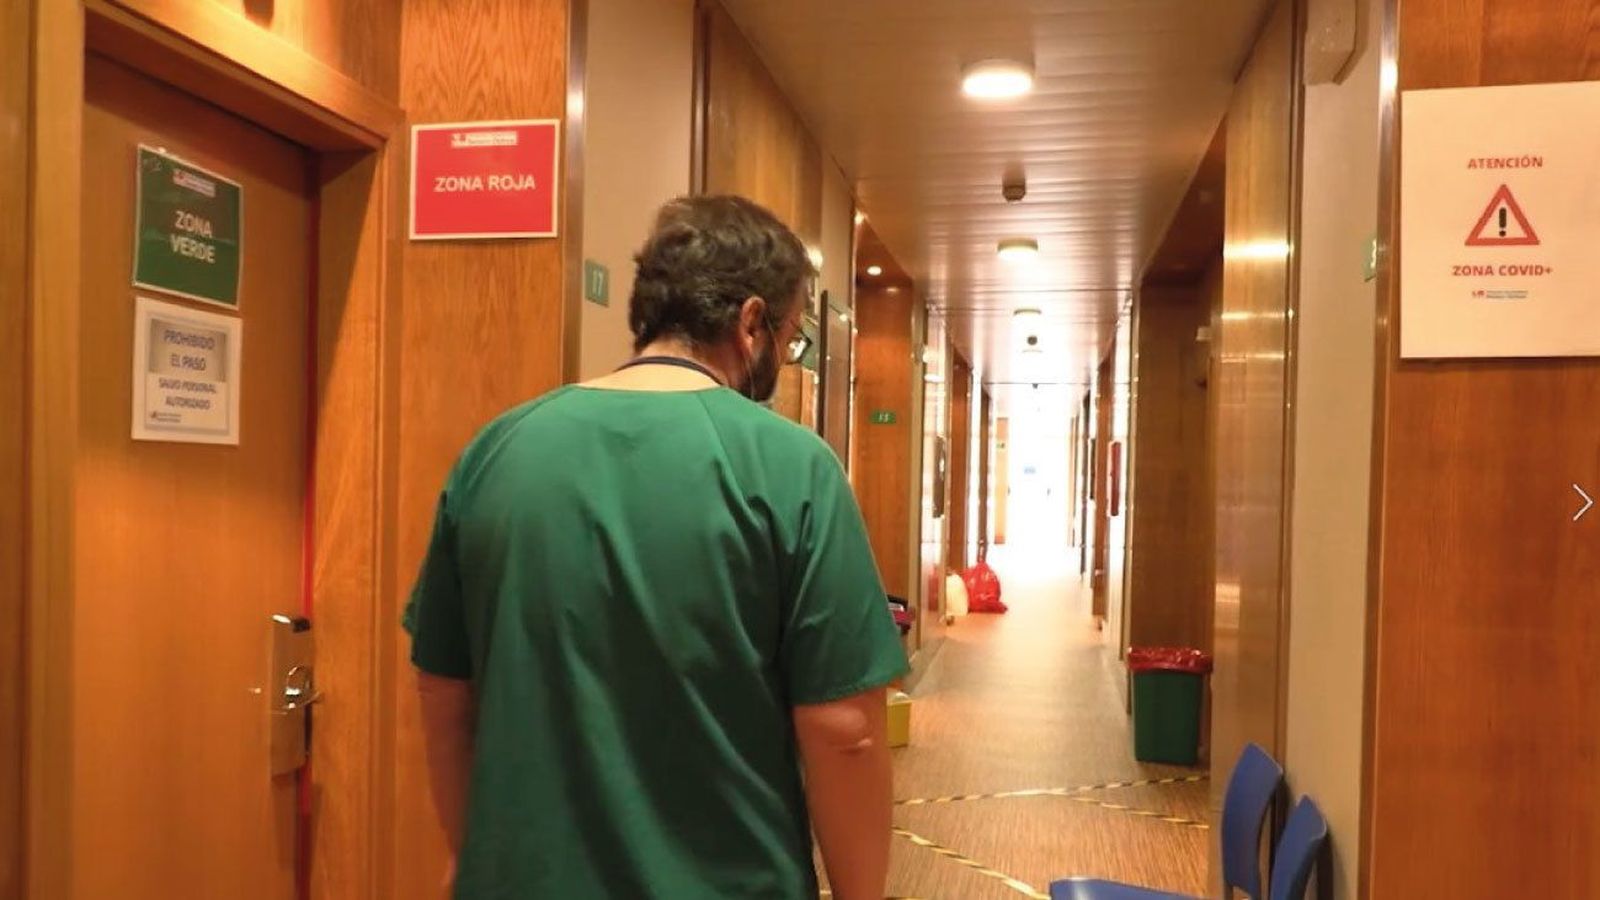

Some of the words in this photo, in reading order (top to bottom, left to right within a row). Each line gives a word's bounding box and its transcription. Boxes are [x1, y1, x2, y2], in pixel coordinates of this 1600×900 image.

[1467, 155, 1544, 169] ATENCIÓN
[433, 176, 484, 192] ZONA
[488, 173, 536, 191] ROJA
[174, 210, 213, 239] ZONA
[170, 234, 216, 265] VERDE
[1452, 265, 1495, 277] ZONA
[1498, 264, 1553, 276] COVID+
[164, 329, 216, 351] PROHIBIDO
[170, 353, 181, 368] EL
[181, 355, 207, 372] PASO
[165, 395, 211, 410] AUTORIZADO
